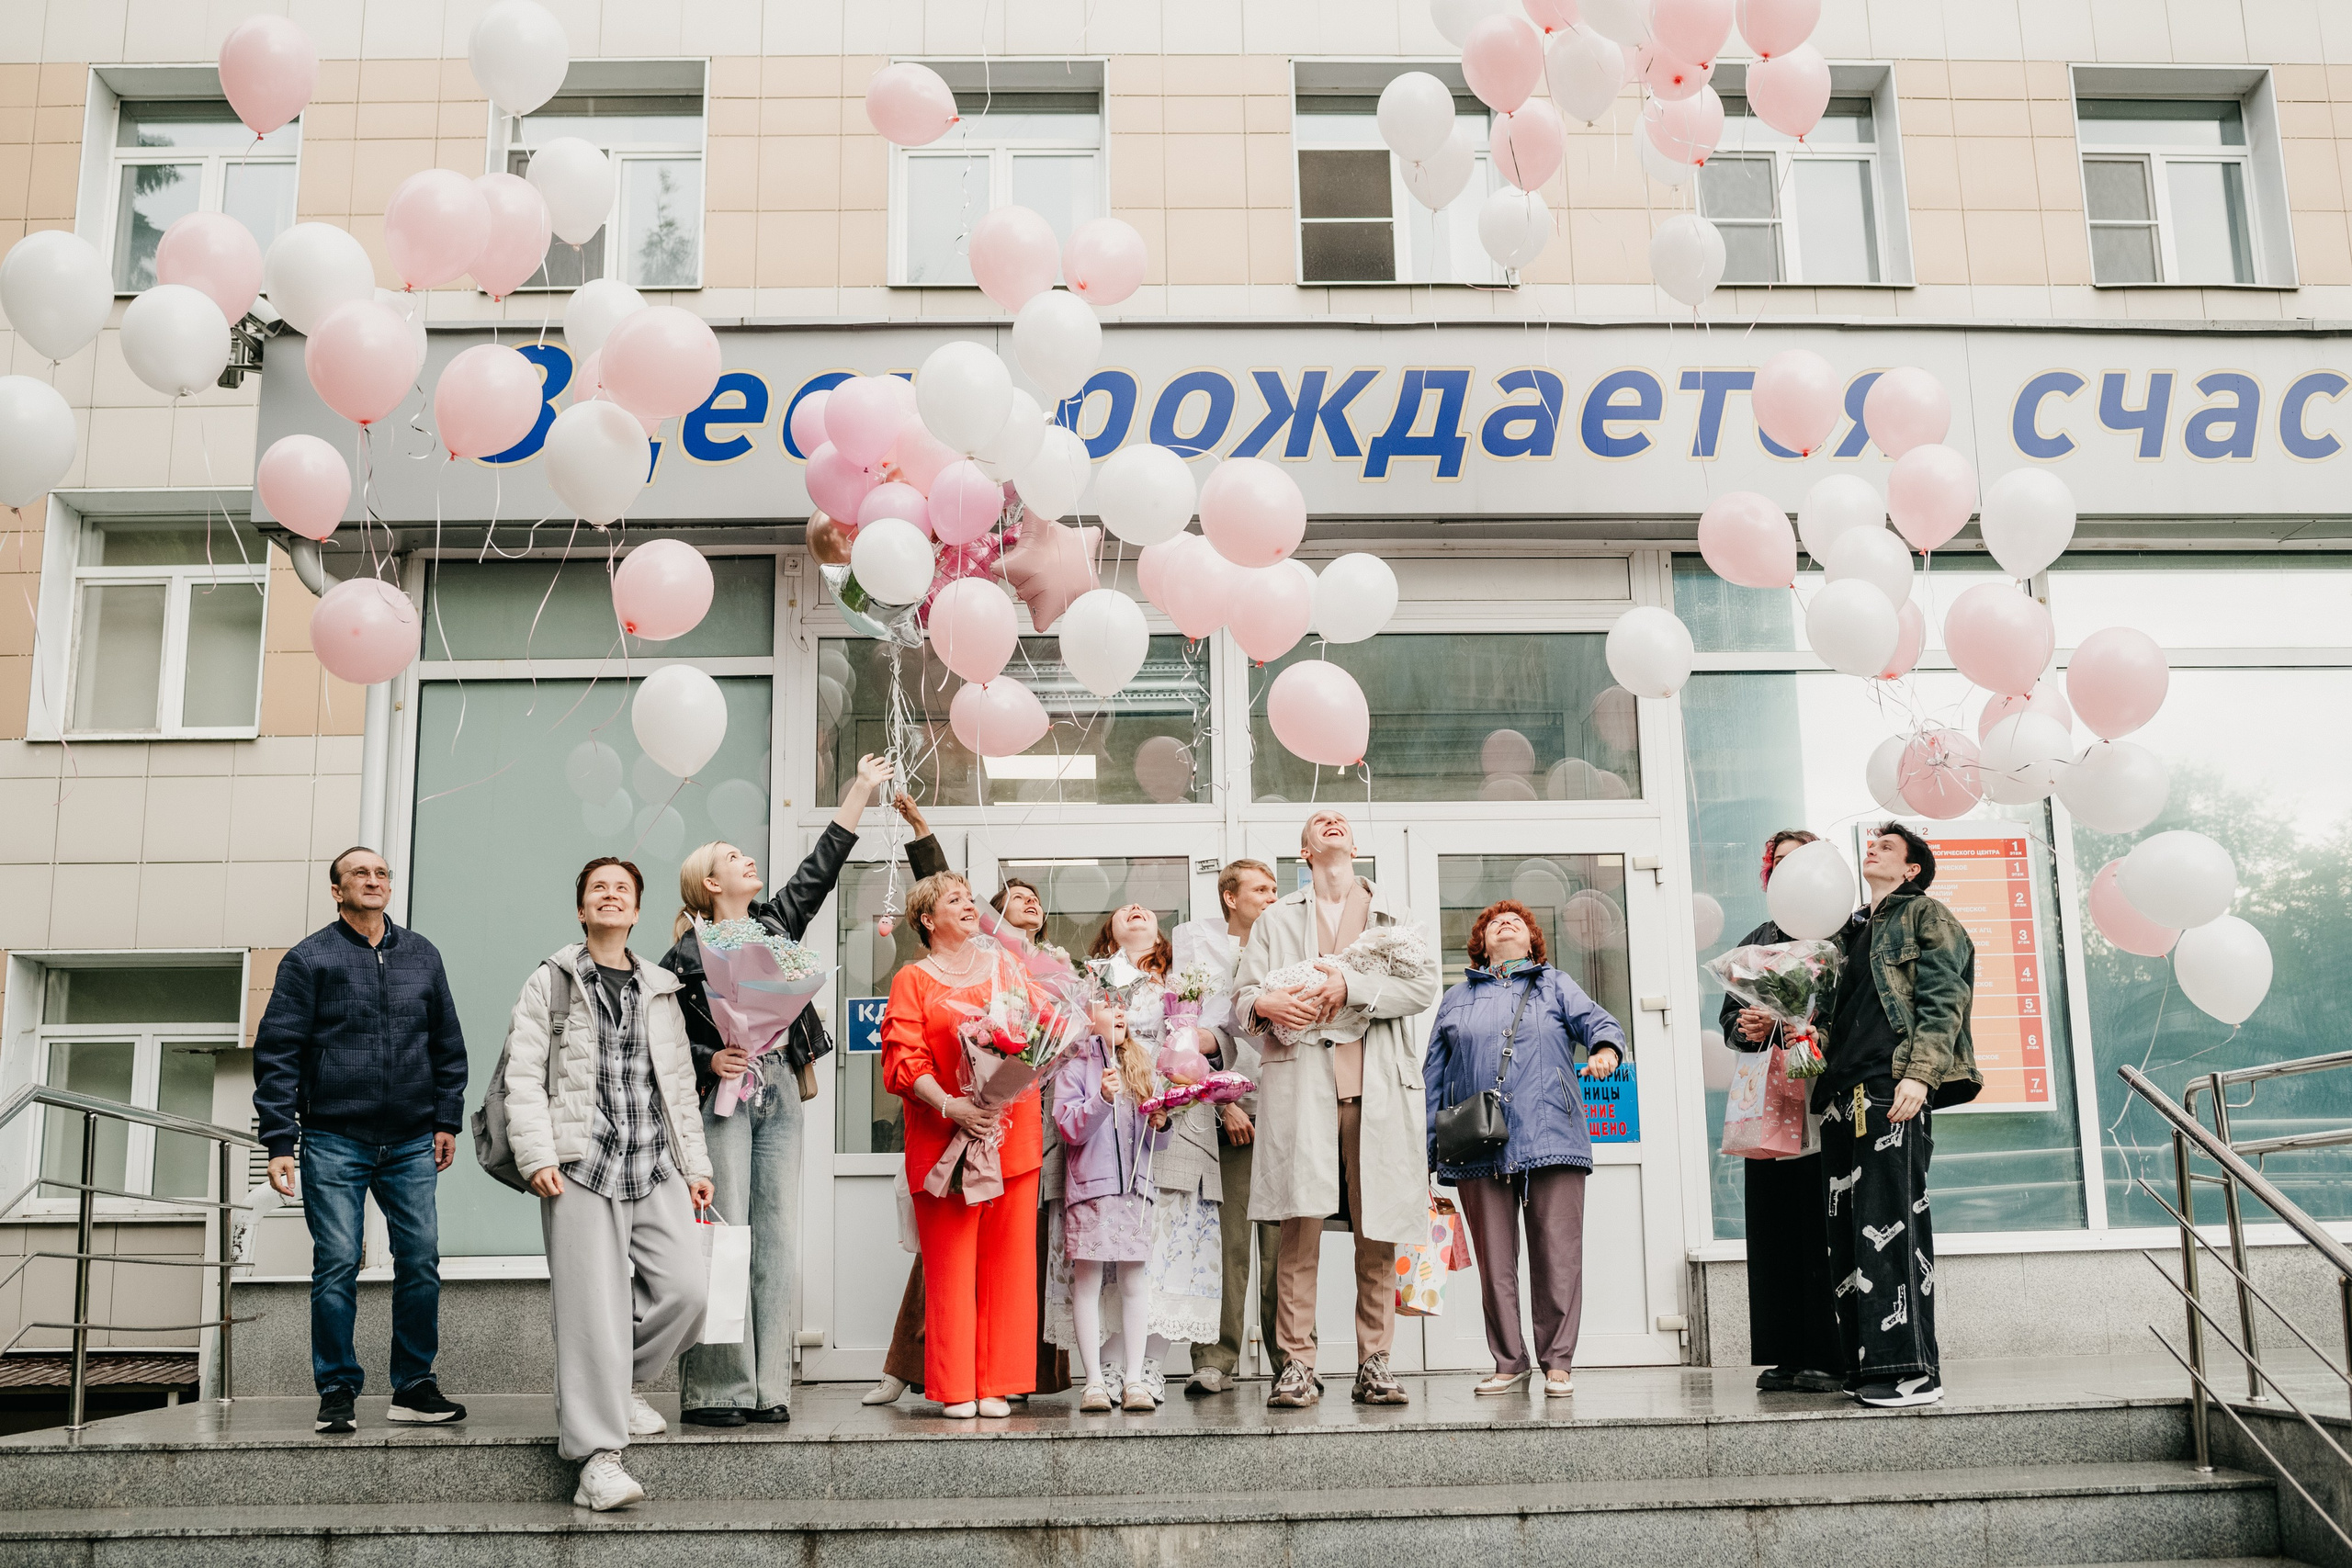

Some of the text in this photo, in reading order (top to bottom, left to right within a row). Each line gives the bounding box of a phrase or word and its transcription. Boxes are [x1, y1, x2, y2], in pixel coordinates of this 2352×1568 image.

[2008, 367, 2352, 464] счас
[2012, 841, 2018, 852] 1
[2014, 862, 2020, 873] 1
[2016, 892, 2024, 903] 2
[2018, 930, 2028, 941] 3
[2022, 967, 2030, 977] 4
[2025, 998, 2033, 1009] 5
[2028, 1034, 2037, 1045] 6
[2031, 1078, 2040, 1089] 7
[1584, 1087, 1620, 1102] НИЦЫ
[1589, 1122, 1626, 1137] ЩЕНО
